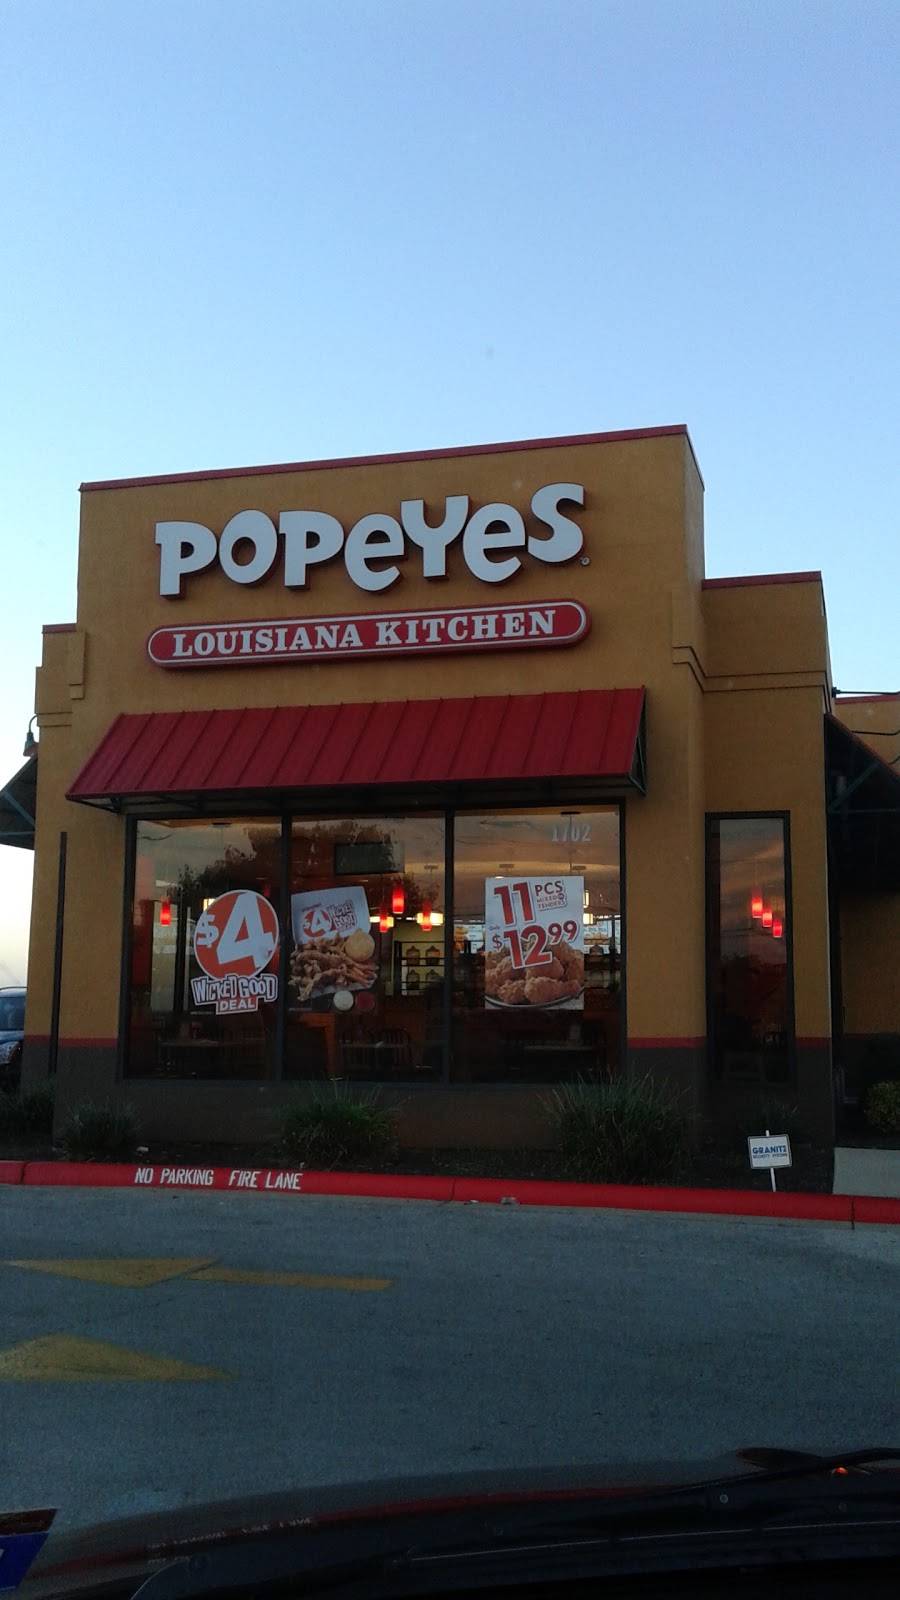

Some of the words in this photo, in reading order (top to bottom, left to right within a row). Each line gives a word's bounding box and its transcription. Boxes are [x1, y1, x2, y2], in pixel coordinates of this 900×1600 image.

[172, 623, 363, 657] LOUISIANA
[375, 609, 556, 647] KITCHEN
[552, 823, 592, 842] 1702
[493, 881, 534, 925] 11
[535, 880, 563, 896] PCS
[239, 976, 276, 1000] GOOD
[220, 998, 255, 1010] DEAL
[134, 1167, 153, 1184] NO
[160, 1167, 214, 1186] PARKING
[228, 1169, 261, 1188] FIRE
[265, 1171, 303, 1190] LANE
